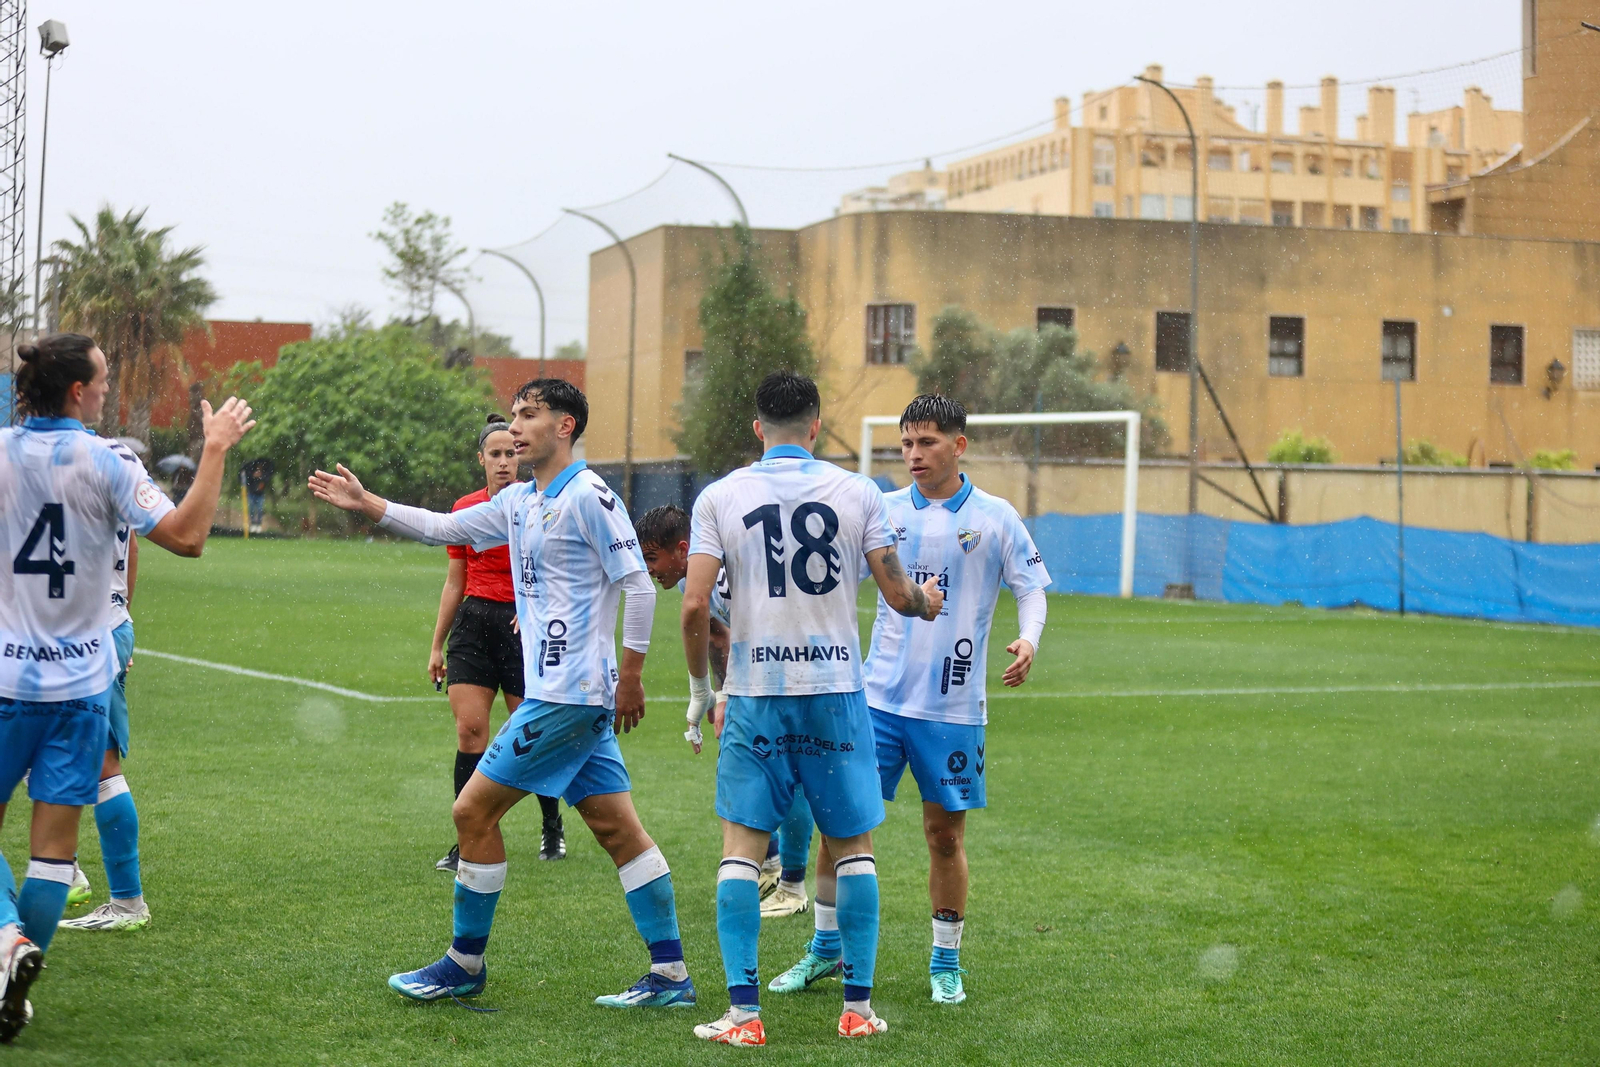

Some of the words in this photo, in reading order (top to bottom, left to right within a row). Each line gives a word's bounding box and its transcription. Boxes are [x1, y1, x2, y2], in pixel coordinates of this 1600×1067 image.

[13, 502, 75, 599] 4
[742, 501, 841, 598] 18
[907, 562, 929, 571] sabor
[4, 638, 101, 663] BENAHAVIS
[545, 618, 568, 667] Olin
[951, 638, 973, 686] Olin
[775, 733, 812, 746] COSTA
[814, 736, 838, 752] DEL
[940, 775, 973, 787] trafilex
